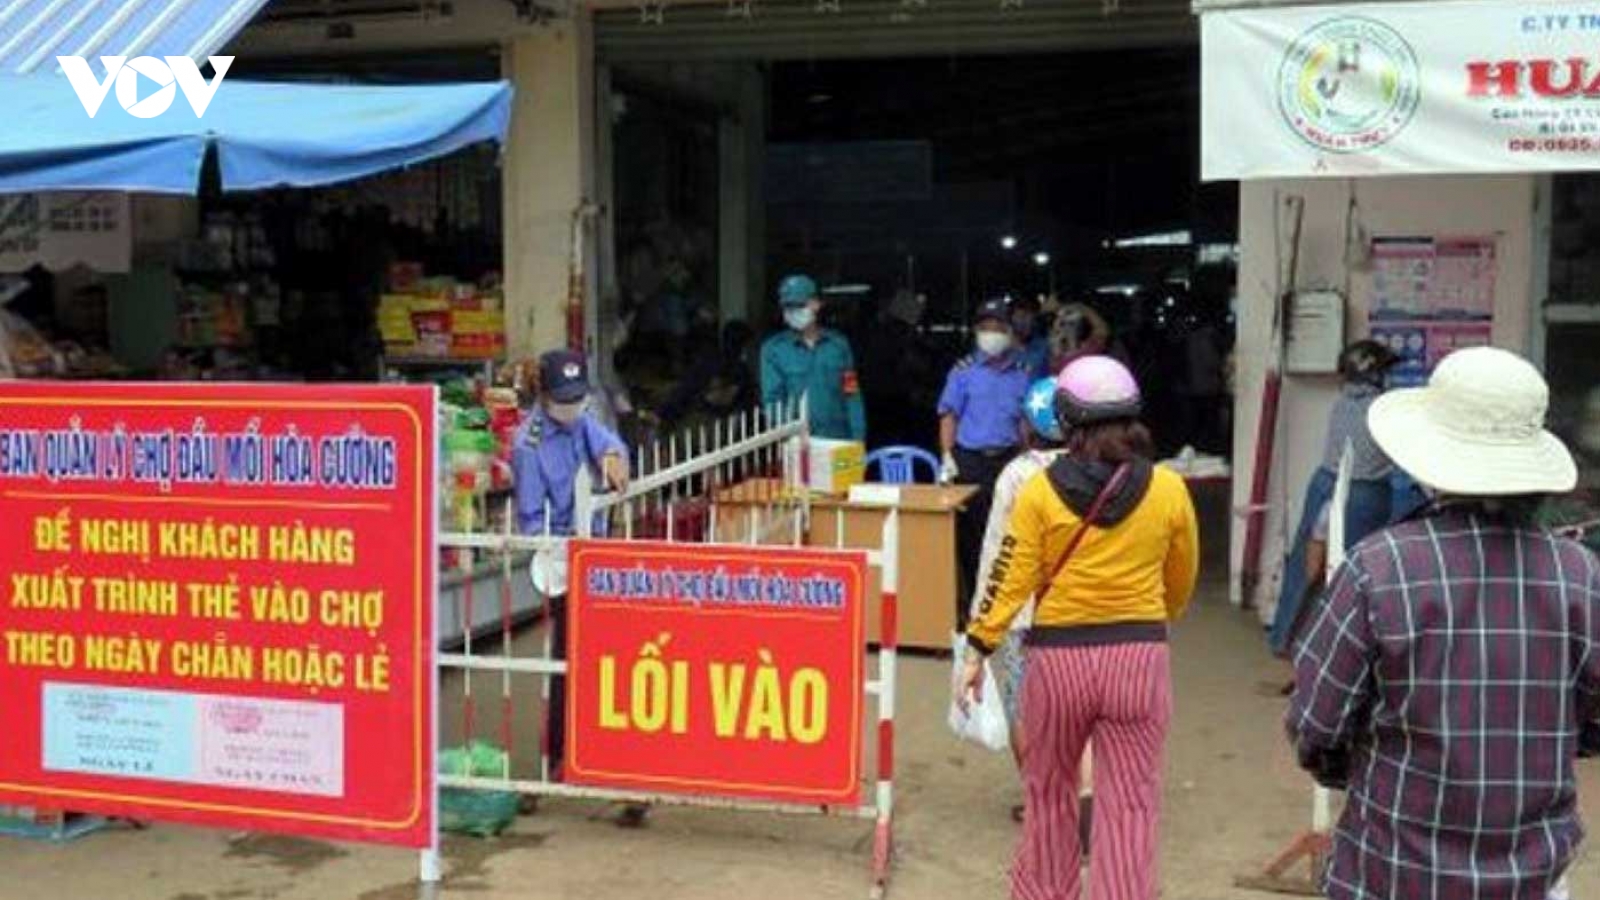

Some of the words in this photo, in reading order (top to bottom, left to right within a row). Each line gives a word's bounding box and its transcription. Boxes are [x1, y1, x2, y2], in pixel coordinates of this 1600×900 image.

[0, 430, 39, 476] BAN
[46, 415, 99, 482] QUẢN
[132, 428, 175, 492] CHỢ
[176, 416, 219, 482] ĐẦU
[222, 416, 266, 484] MỐI
[270, 423, 316, 486] HÒA
[319, 422, 397, 490] CƯỜNG
[80, 517, 149, 563] NGHỊ
[159, 516, 260, 561] KHÁCH
[269, 519, 355, 566] HÀNG
[11, 564, 85, 611] XUẤT
[92, 571, 178, 617] TRÌNH
[186, 572, 242, 620] THẺ
[250, 579, 311, 627] VÀO
[320, 588, 384, 638] CHỢ
[4, 630, 76, 669] THEO
[85, 631, 163, 675] NGÀY
[262, 643, 345, 695] HOẶC
[355, 643, 391, 692] LẺ
[599, 631, 689, 734] LỐI
[708, 647, 830, 745] VÀO
